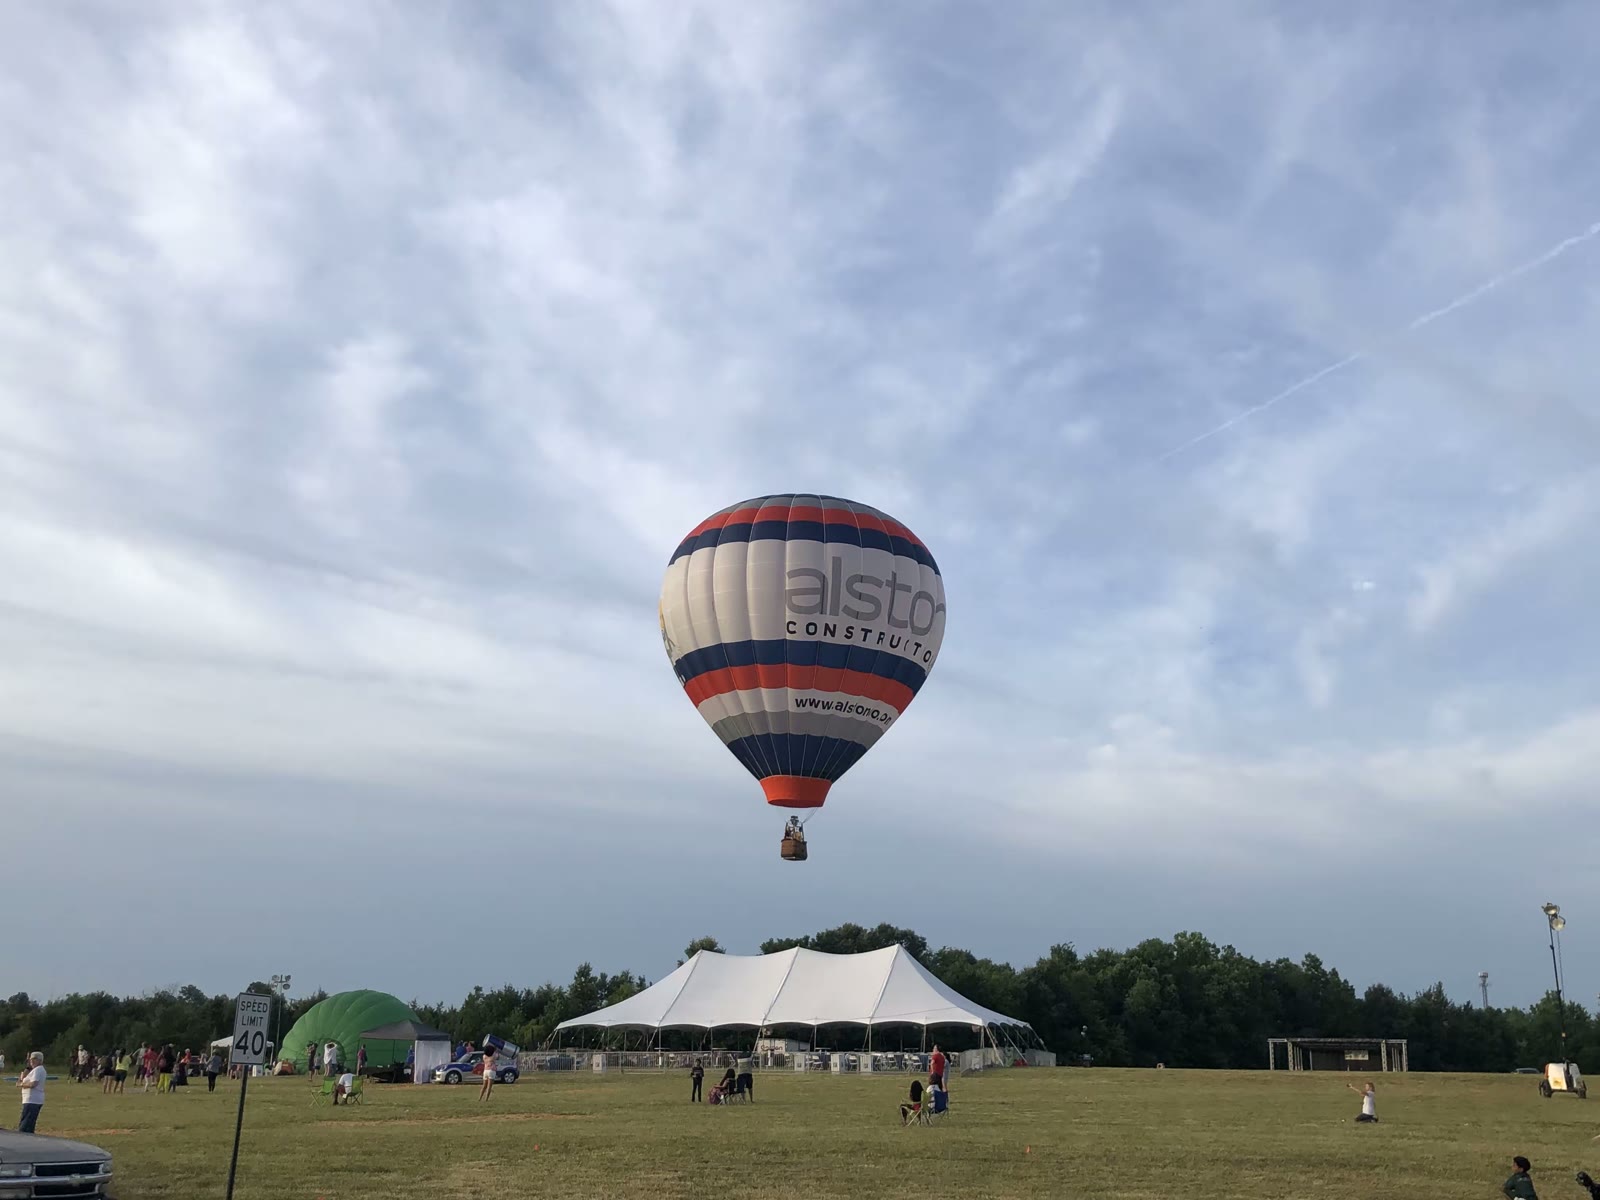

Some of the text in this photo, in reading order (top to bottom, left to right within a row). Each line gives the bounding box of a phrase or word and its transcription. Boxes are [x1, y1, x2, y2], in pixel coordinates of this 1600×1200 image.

[240, 1000, 268, 1013] SPEED
[241, 1015, 264, 1027] LIMIT
[234, 1030, 264, 1056] 40
